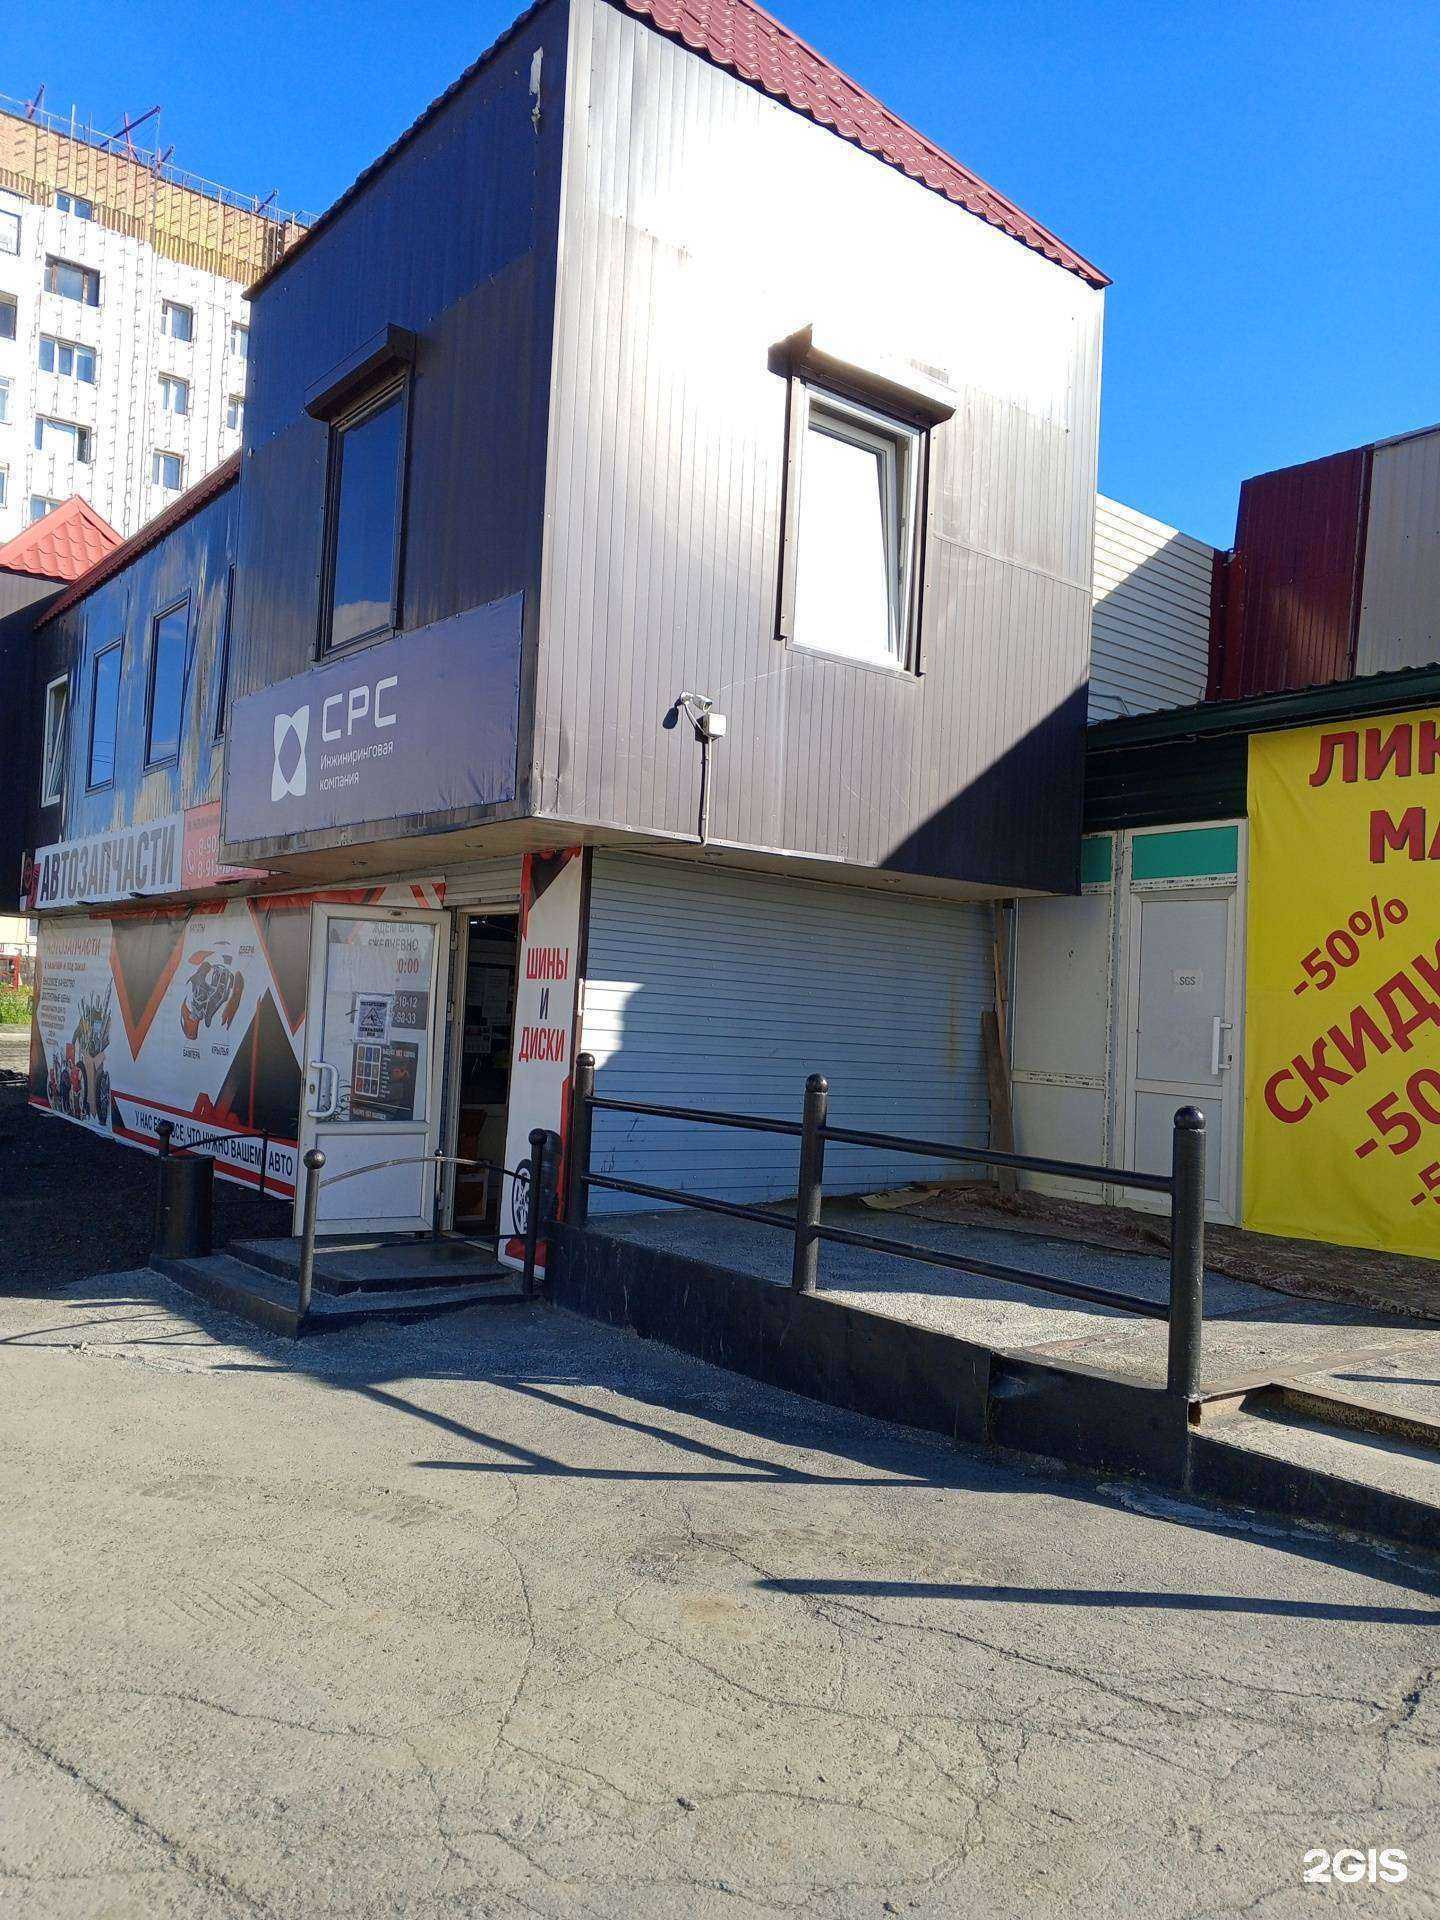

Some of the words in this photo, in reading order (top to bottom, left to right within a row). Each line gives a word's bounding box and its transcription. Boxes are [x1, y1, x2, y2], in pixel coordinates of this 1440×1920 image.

[322, 675, 398, 742] СРС
[320, 741, 394, 770] Инжиниринговая
[319, 771, 360, 792] компания
[40, 824, 176, 902] АВТОЗАПЧАСТИ
[1293, 894, 1409, 996] -50%
[526, 947, 569, 980] ШИНЫ
[1179, 976, 1196, 986] SGS
[540, 987, 549, 1020] И
[518, 1026, 565, 1062] ДИСКИ
[135, 1110, 140, 1127] У
[140, 1111, 153, 1131] НАС
[187, 1126, 201, 1147] ЧТО
[201, 1130, 229, 1156] НУЖНО
[268, 1146, 293, 1176] АВТО
